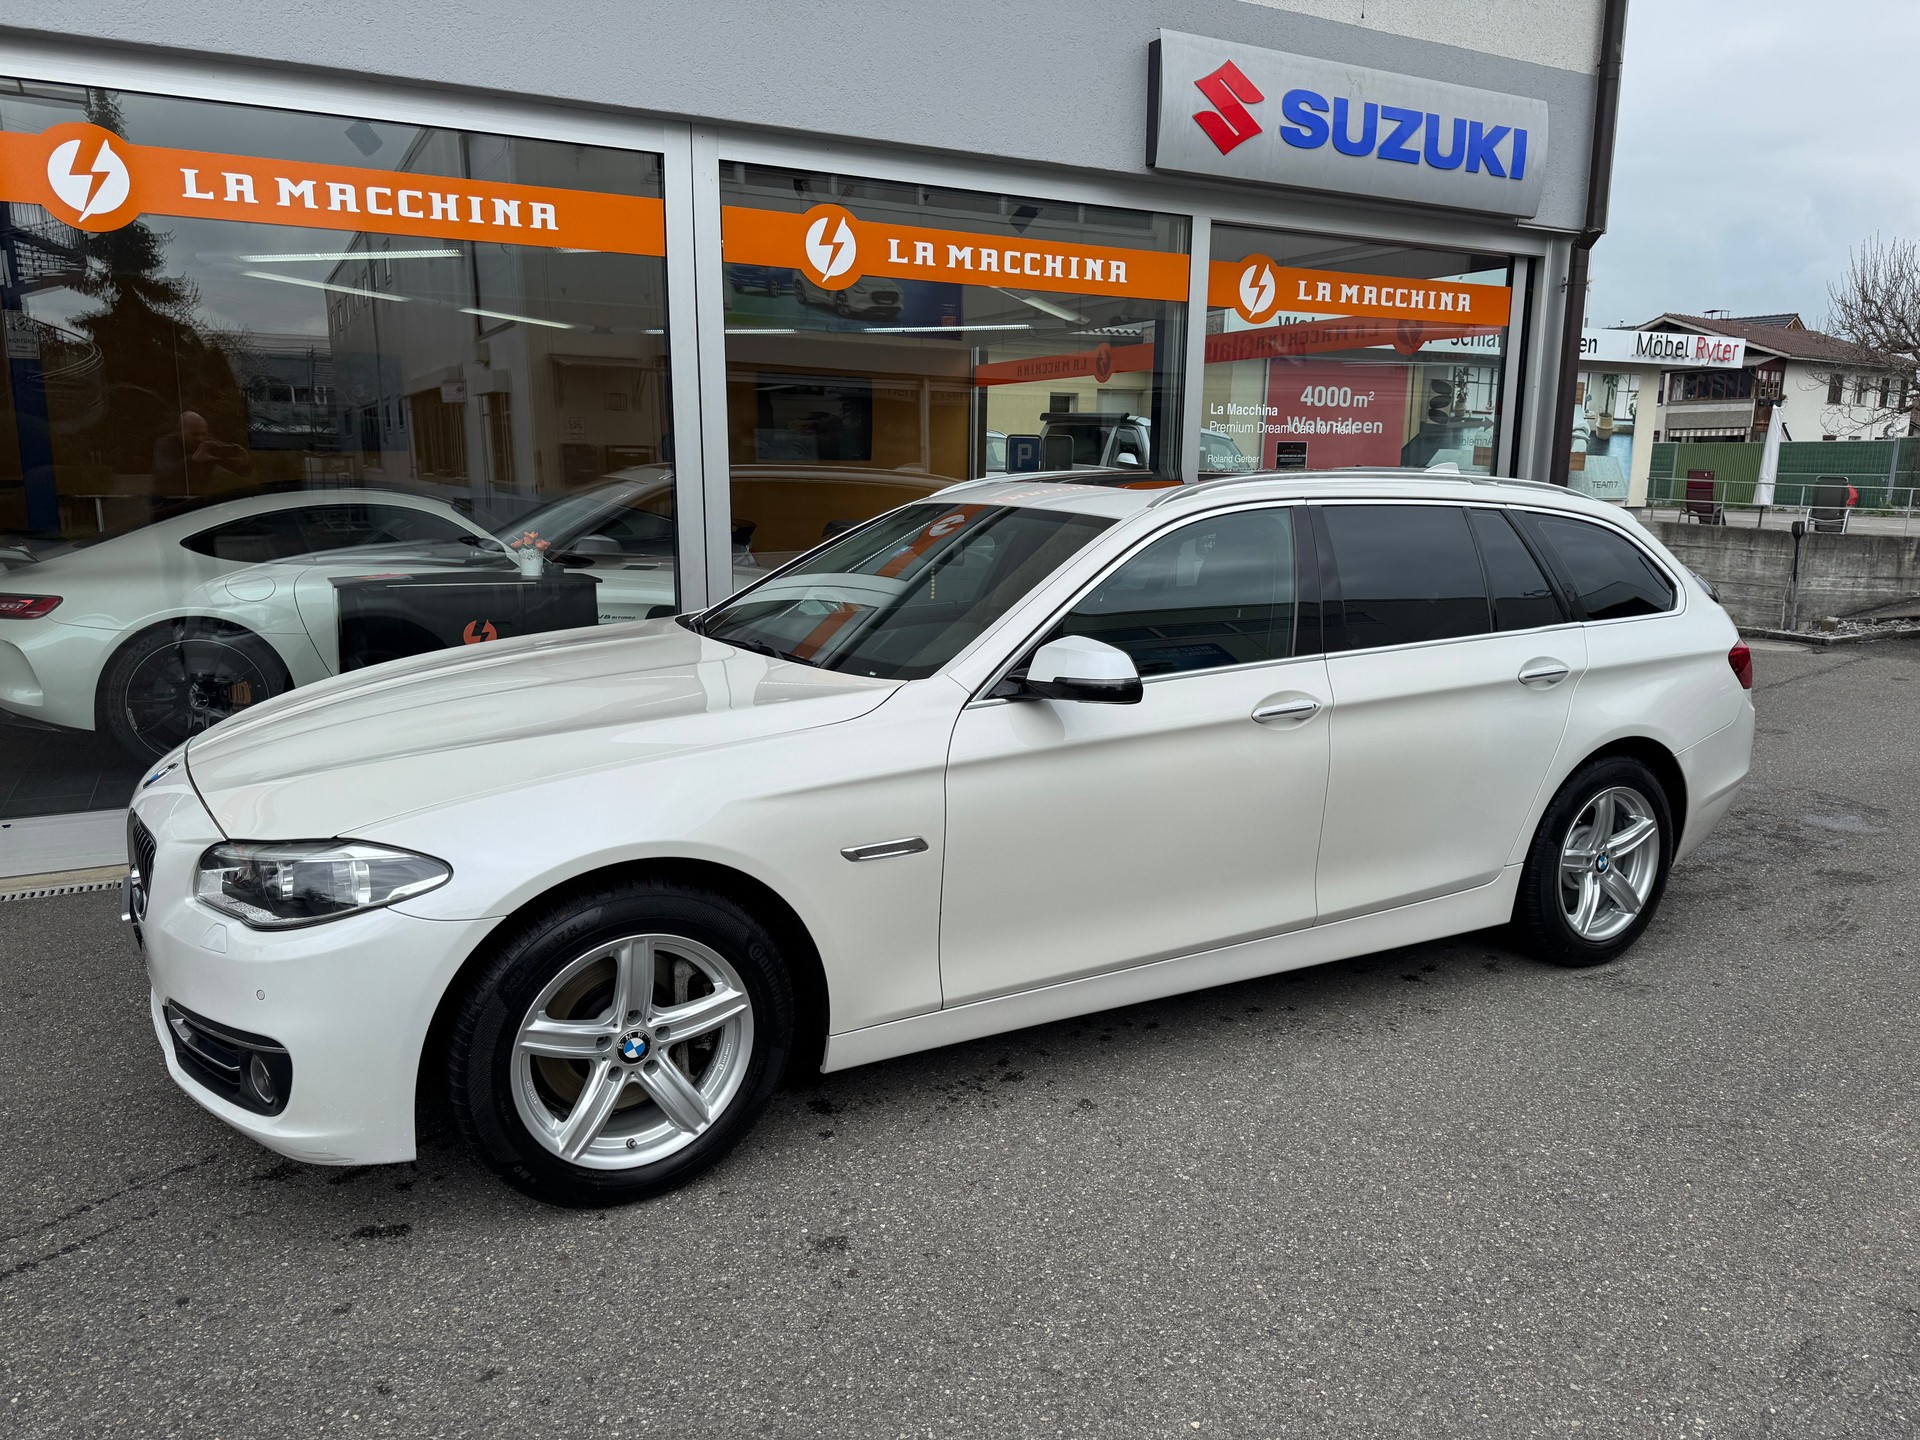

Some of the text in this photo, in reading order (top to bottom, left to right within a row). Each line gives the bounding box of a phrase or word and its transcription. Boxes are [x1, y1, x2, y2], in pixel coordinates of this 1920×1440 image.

[1280, 88, 1528, 180] SUZUKI
[180, 168, 559, 231] LA MACCHINA
[888, 238, 1128, 284] LA MACCHINA
[1297, 280, 1472, 312] LA MACCHINA
[1636, 333, 1690, 358] Möbel
[1695, 336, 1740, 365] Ryter
[1300, 385, 1352, 408] 4000
[1210, 403, 1278, 416] La Macchina
[1209, 421, 1254, 434] Premium
[1257, 421, 1290, 434] Dream
[1293, 422, 1315, 434] Cars
[1317, 423, 1331, 434] for
[1287, 416, 1383, 434] Wohnideen
[1017, 443, 1033, 468] P
[1207, 454, 1260, 464] Roland Gerber
[617, 1031, 645, 1050] BMW
